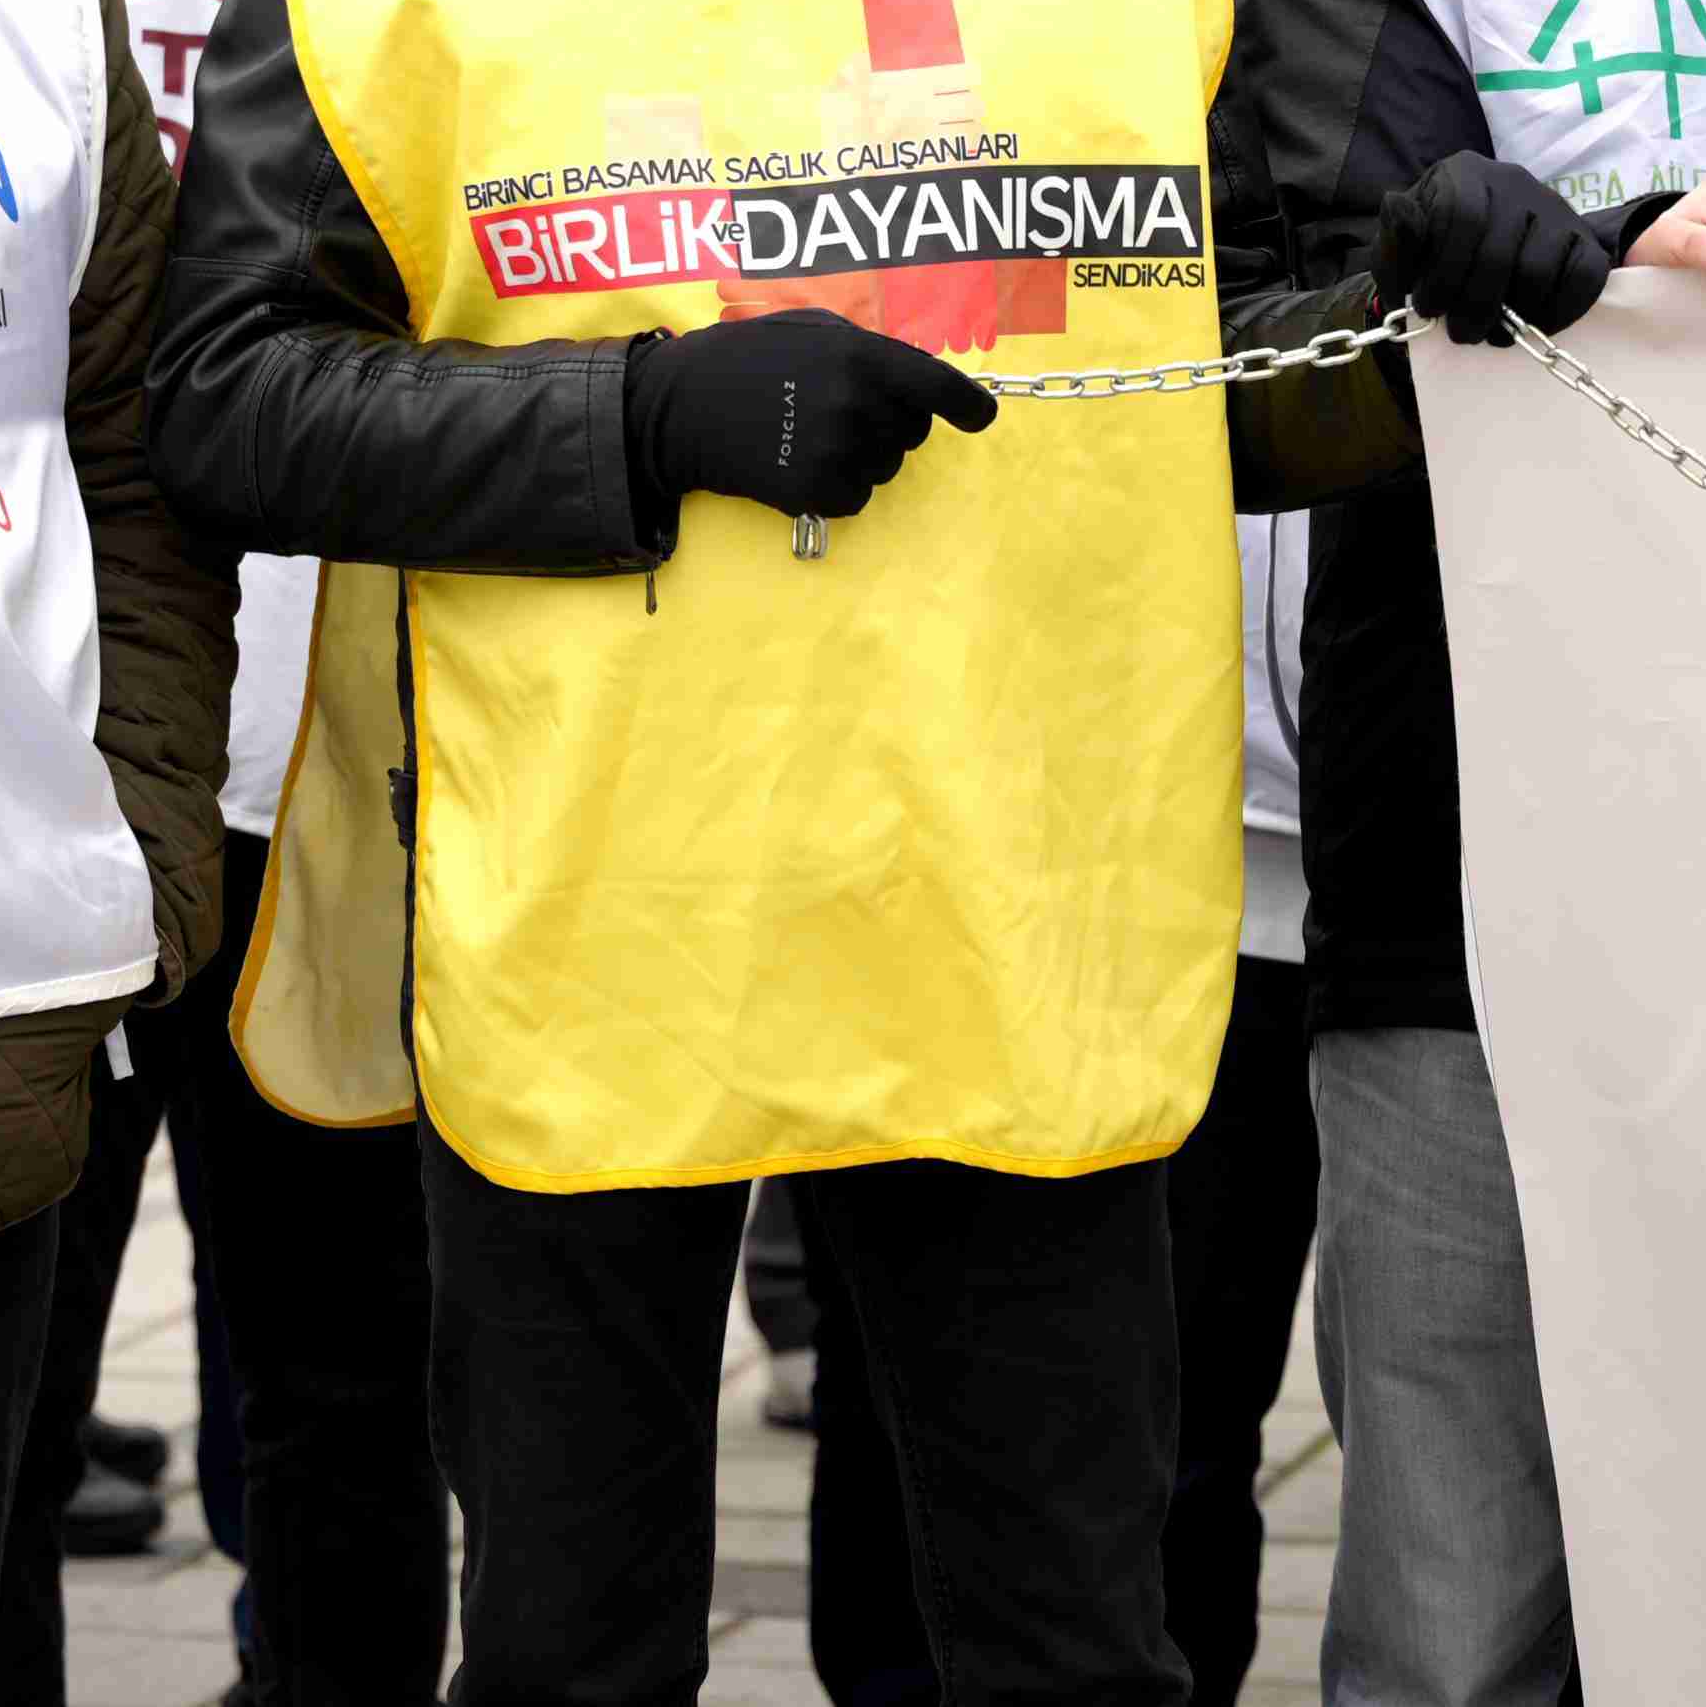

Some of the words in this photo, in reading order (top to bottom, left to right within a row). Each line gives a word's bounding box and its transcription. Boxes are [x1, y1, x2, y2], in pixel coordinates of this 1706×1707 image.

[563, 157, 716, 194] BASAMAK
[724, 151, 828, 183] SAĞLIK
[837, 133, 1018, 175] ÇALIŞANLARI
[711, 221, 745, 244] ve
[733, 175, 1198, 271] DAYANIŞMA
[778, 381, 796, 467] FORCLAZ
